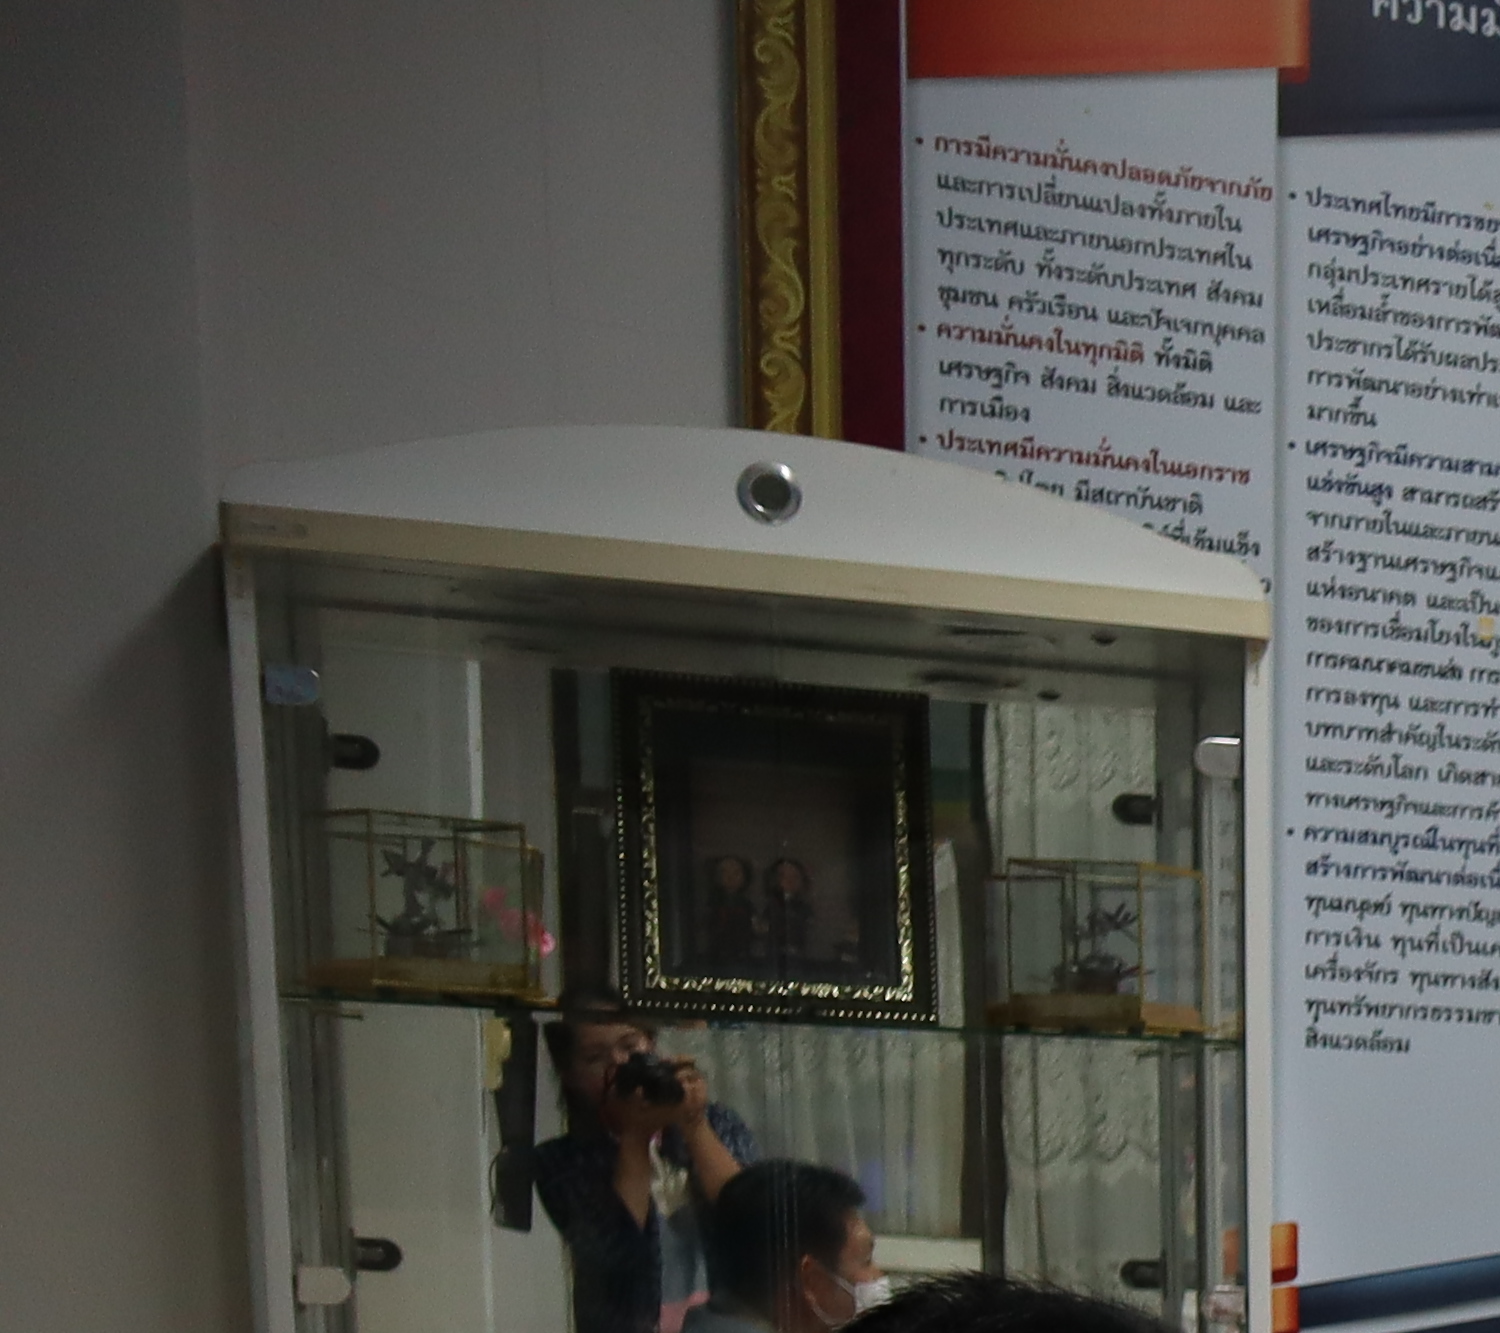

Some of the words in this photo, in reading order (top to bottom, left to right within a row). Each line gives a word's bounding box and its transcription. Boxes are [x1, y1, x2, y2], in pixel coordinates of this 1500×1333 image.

[1206, 280, 1263, 309] สังคม
[939, 359, 1030, 389] เศรษฐกิจ
[1041, 366, 1096, 395] สังคม
[939, 395, 1030, 422] การเมือง
